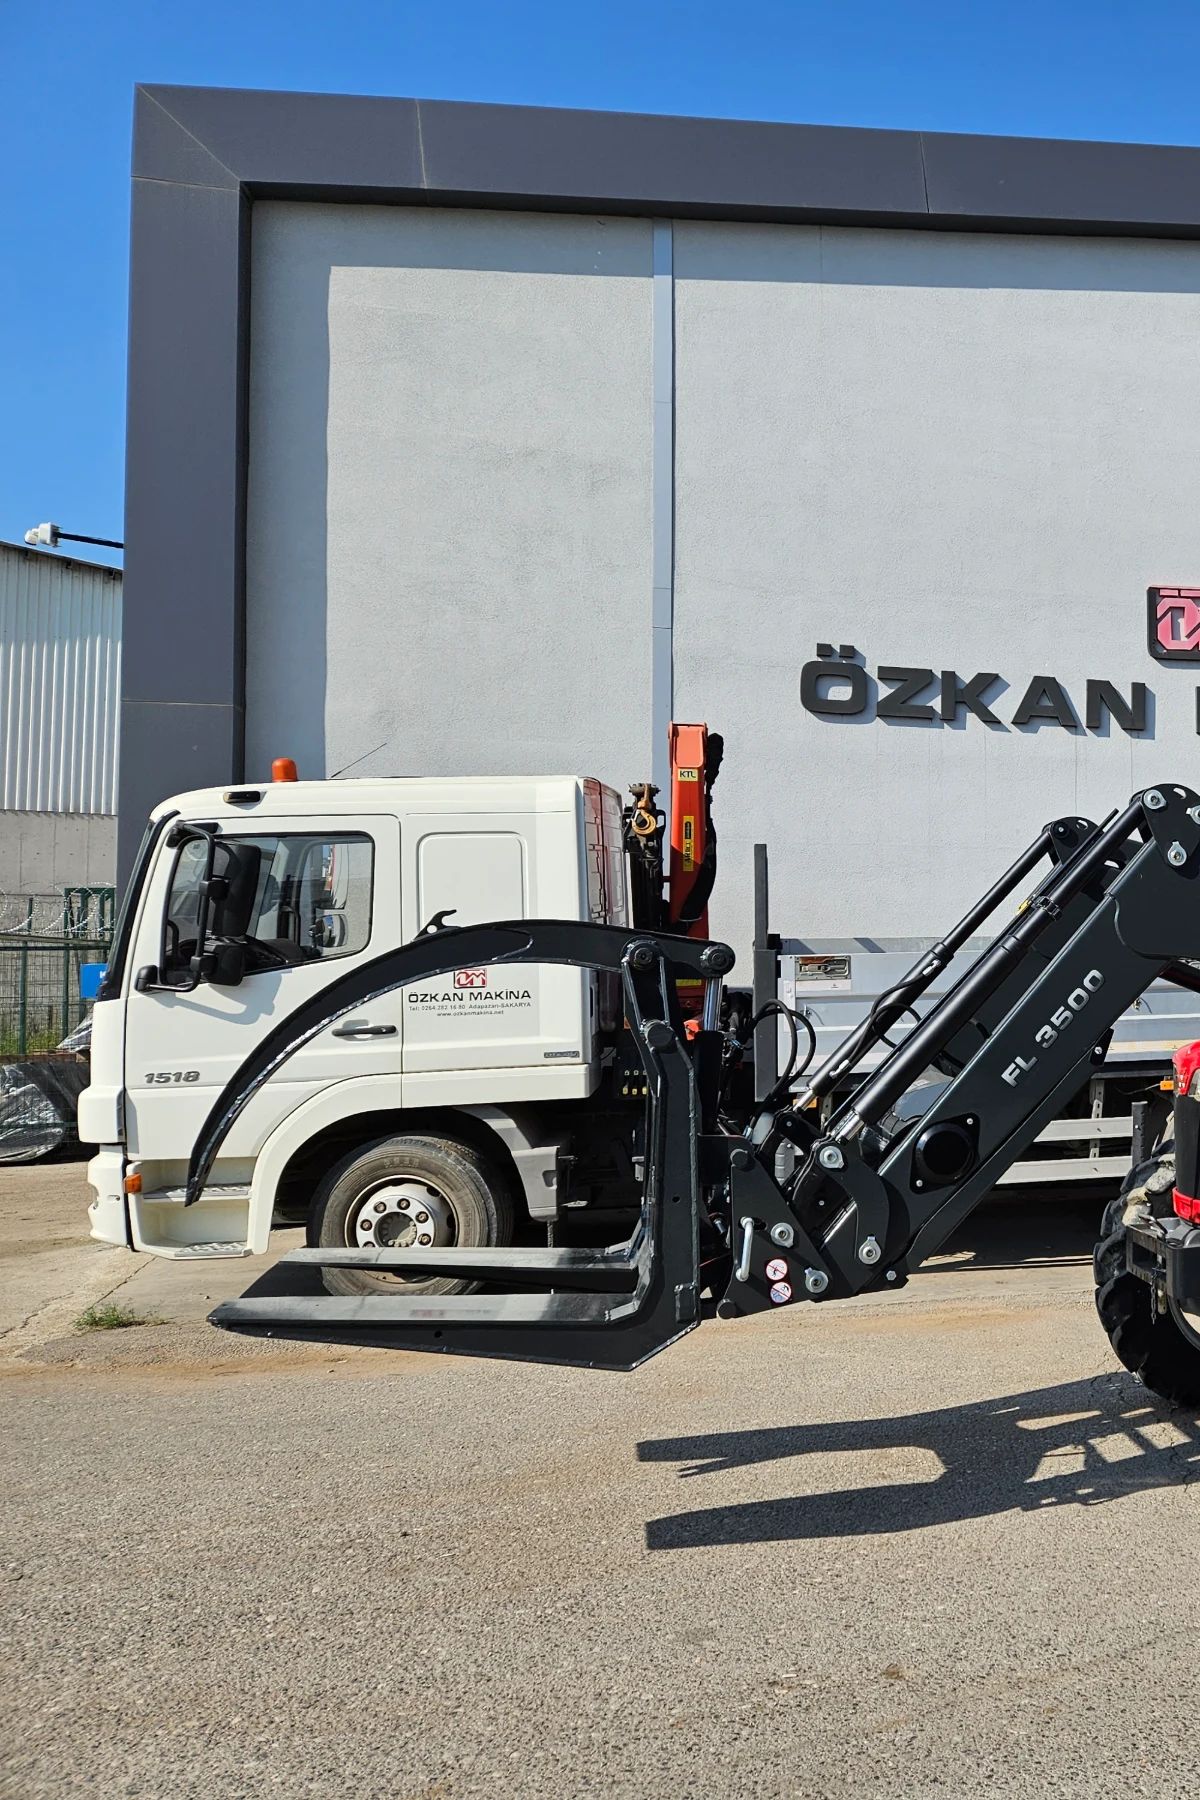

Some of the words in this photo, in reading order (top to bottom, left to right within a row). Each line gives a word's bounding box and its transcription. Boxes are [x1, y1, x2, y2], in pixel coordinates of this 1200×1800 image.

[800, 642, 1146, 731] ÖZKAN
[679, 770, 696, 779] KTL
[408, 991, 464, 1003] ÖZKAN
[469, 988, 532, 1001] MAKİNA
[1001, 1056, 1038, 1088] FL
[1035, 969, 1105, 1049] 3500
[144, 1070, 201, 1084] 1518
